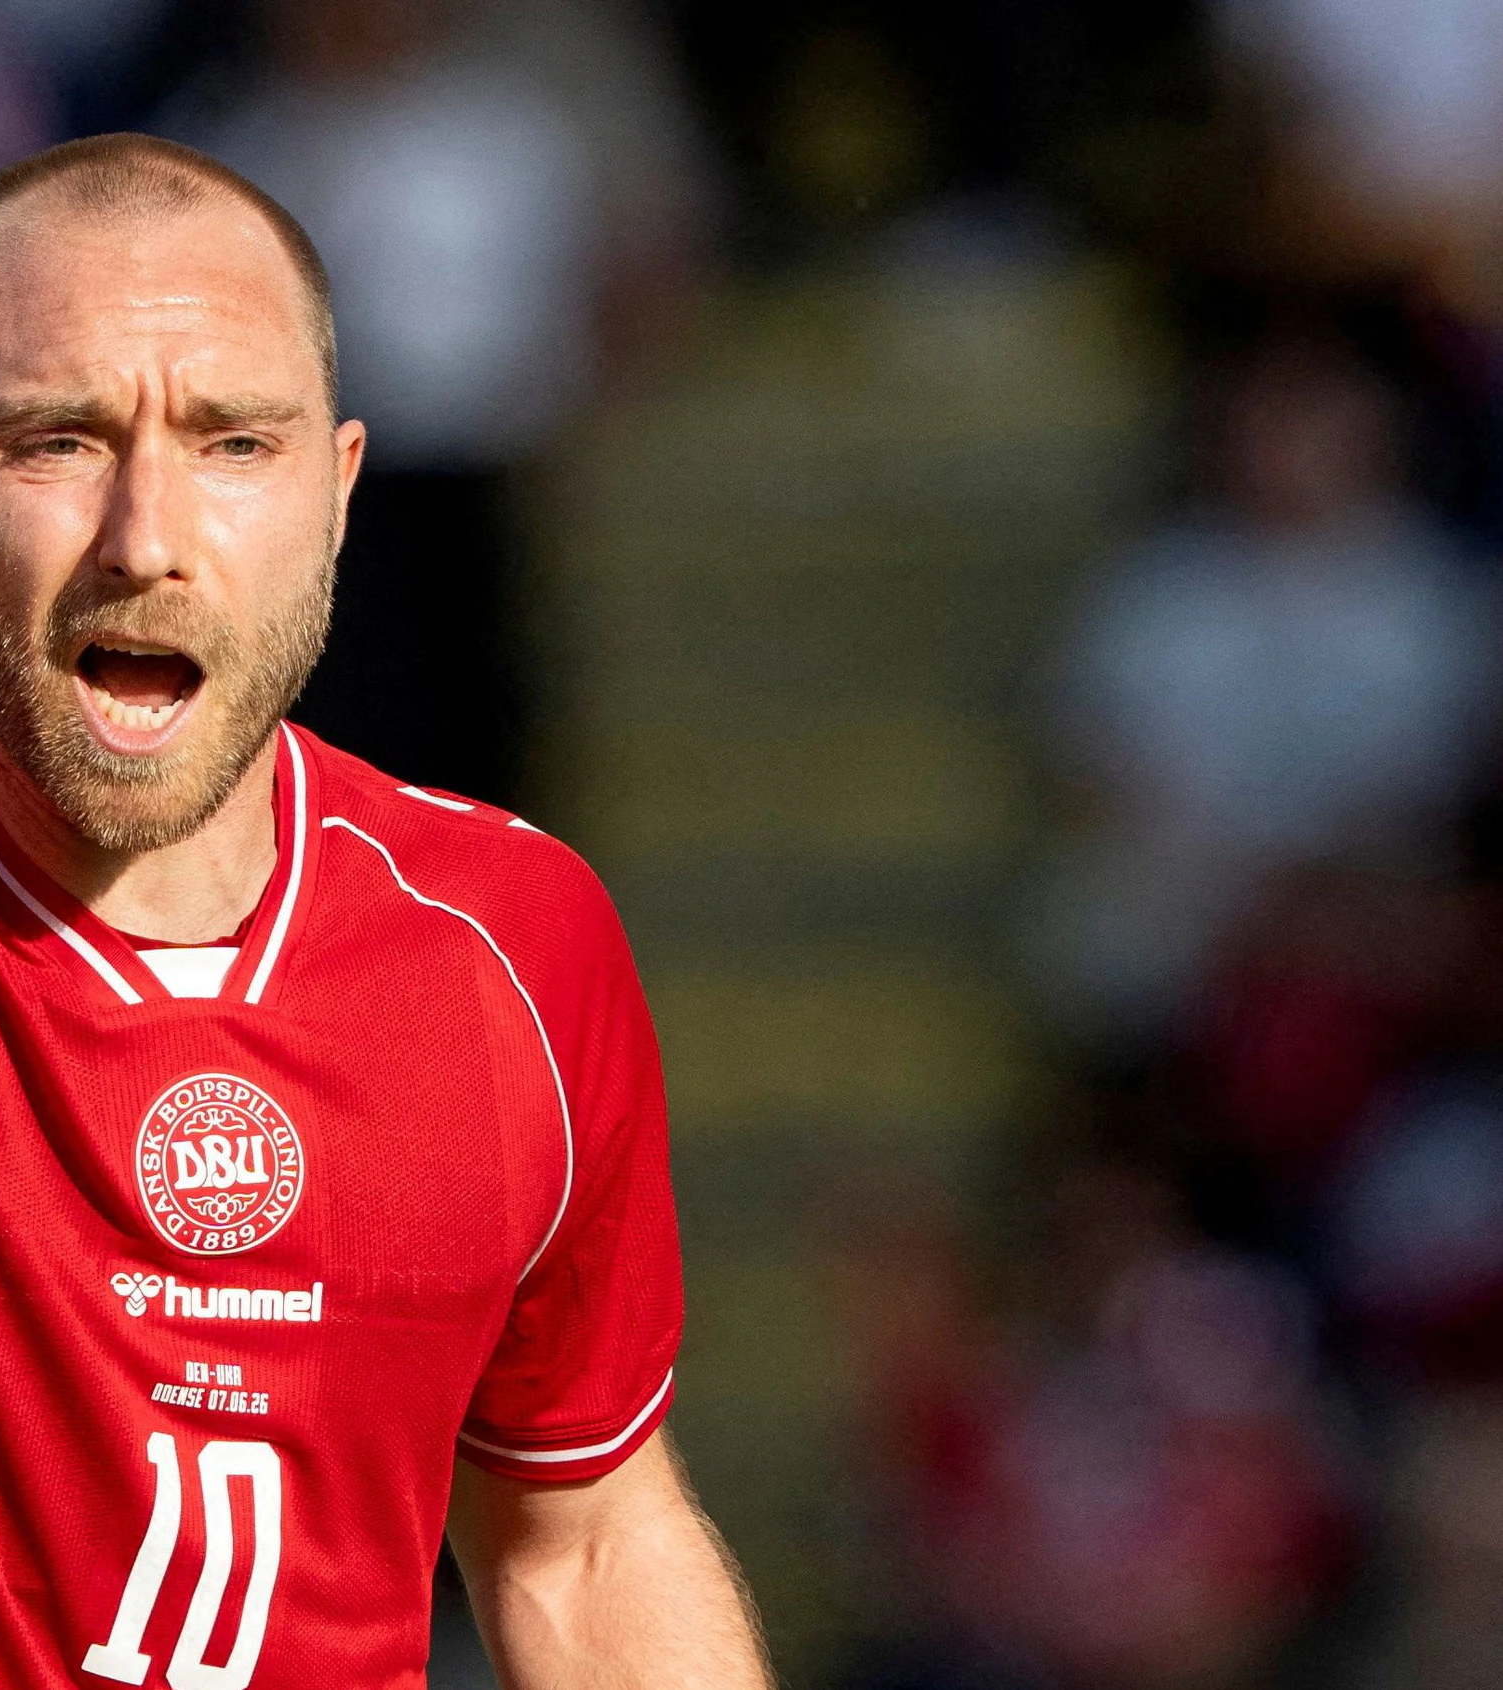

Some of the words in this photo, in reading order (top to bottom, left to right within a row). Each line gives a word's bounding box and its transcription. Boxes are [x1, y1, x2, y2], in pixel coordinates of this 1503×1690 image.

[143, 1129, 186, 1235] DANSK
[171, 1135, 270, 1190] DBU
[189, 1224, 256, 1250] 1889
[165, 1276, 323, 1322] hummel
[185, 1361, 242, 1386] DEN-UKR
[151, 1383, 205, 1408] ODENSE
[207, 1389, 269, 1414] 07.06.26
[81, 1431, 281, 1690] 10
